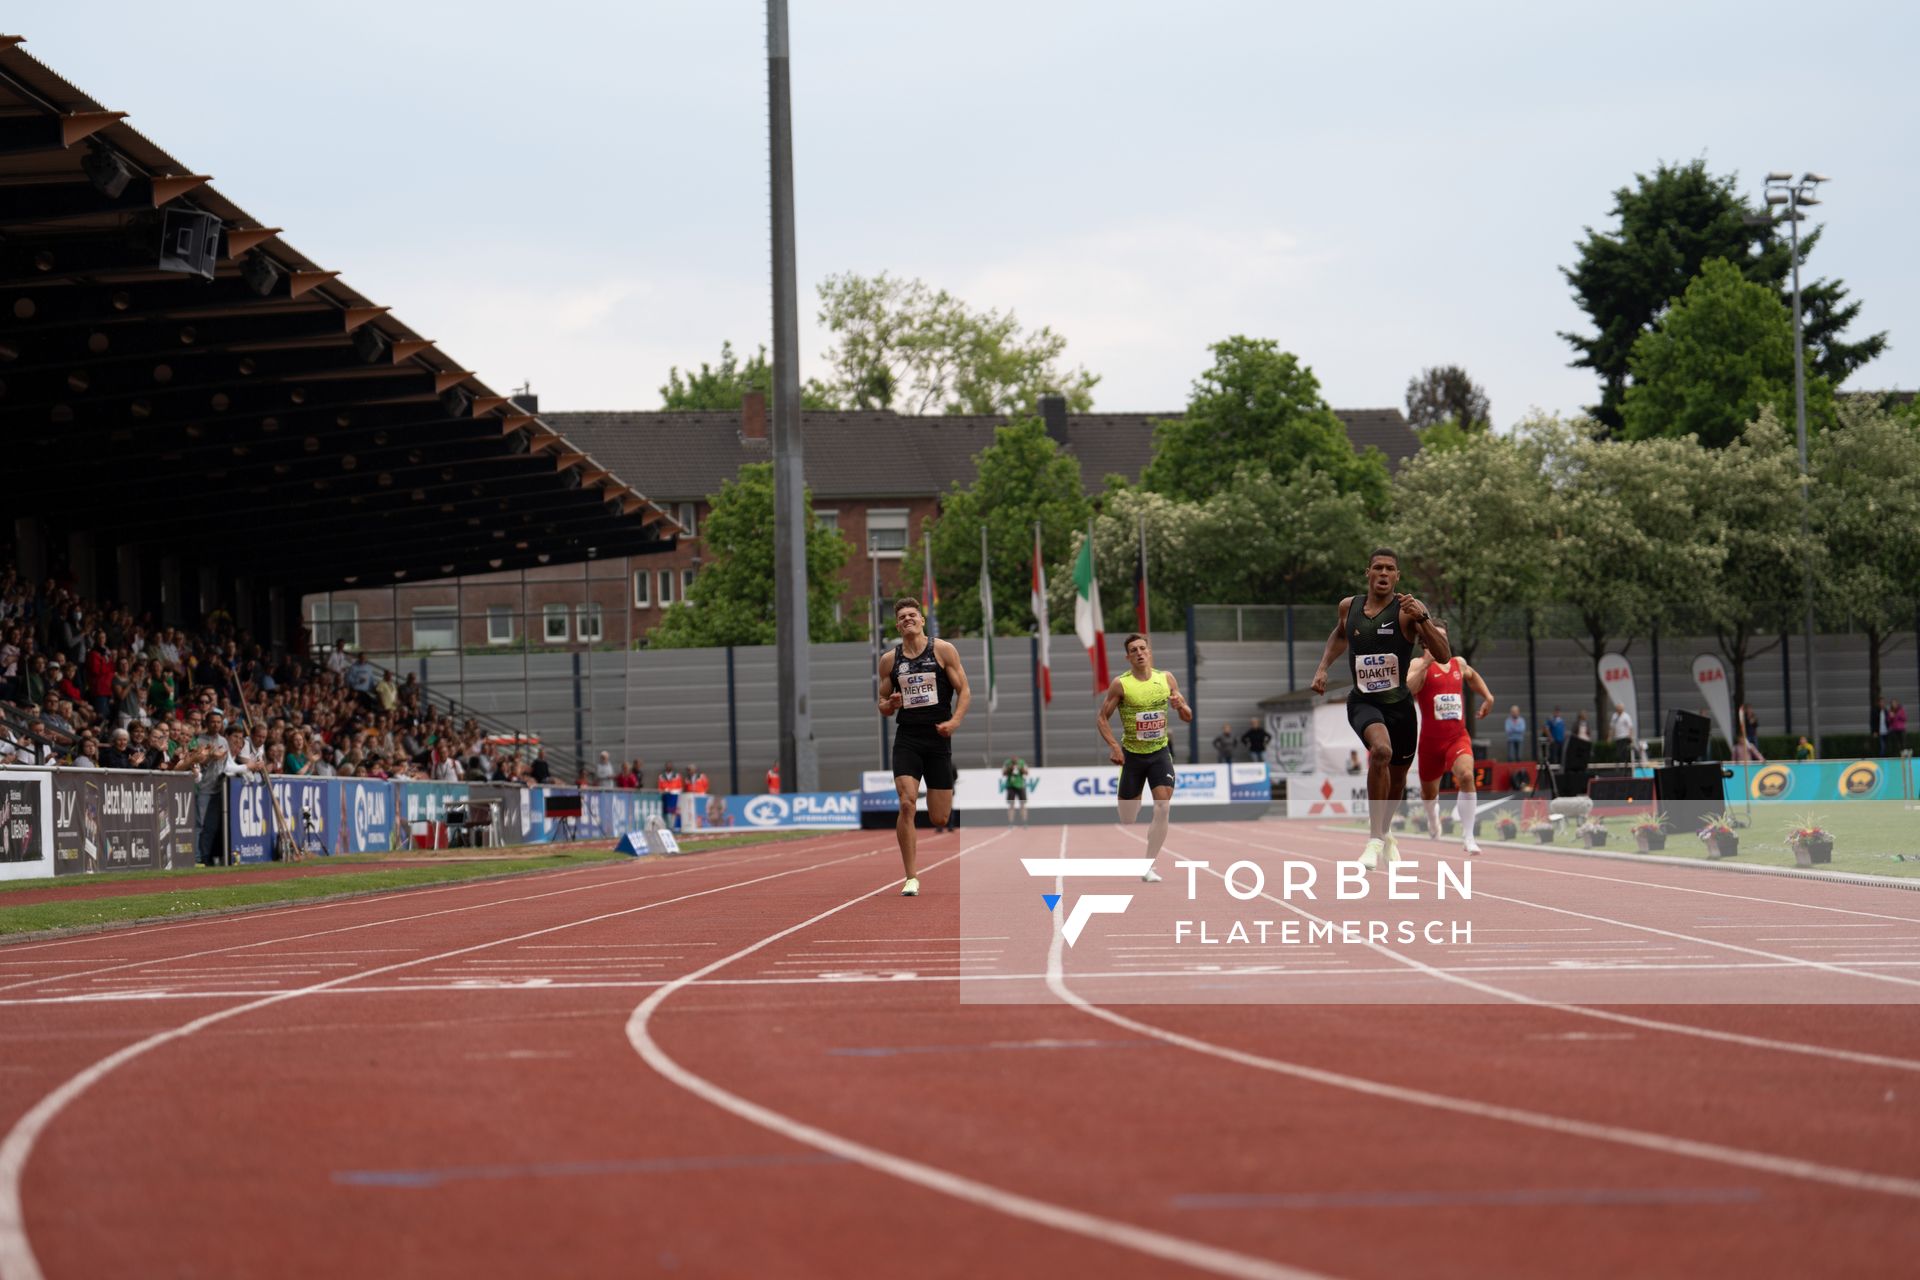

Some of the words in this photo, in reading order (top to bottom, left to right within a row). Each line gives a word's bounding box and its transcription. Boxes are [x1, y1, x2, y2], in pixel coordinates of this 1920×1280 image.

[1364, 656, 1386, 666] GLS
[1358, 663, 1397, 679] DIAKITÉ
[907, 675, 924, 684] GLS
[903, 683, 934, 696] MEYER
[1143, 712, 1158, 721] GLS
[1073, 777, 1119, 796] GLS
[121, 783, 132, 823] App
[793, 796, 858, 814] PLAN
